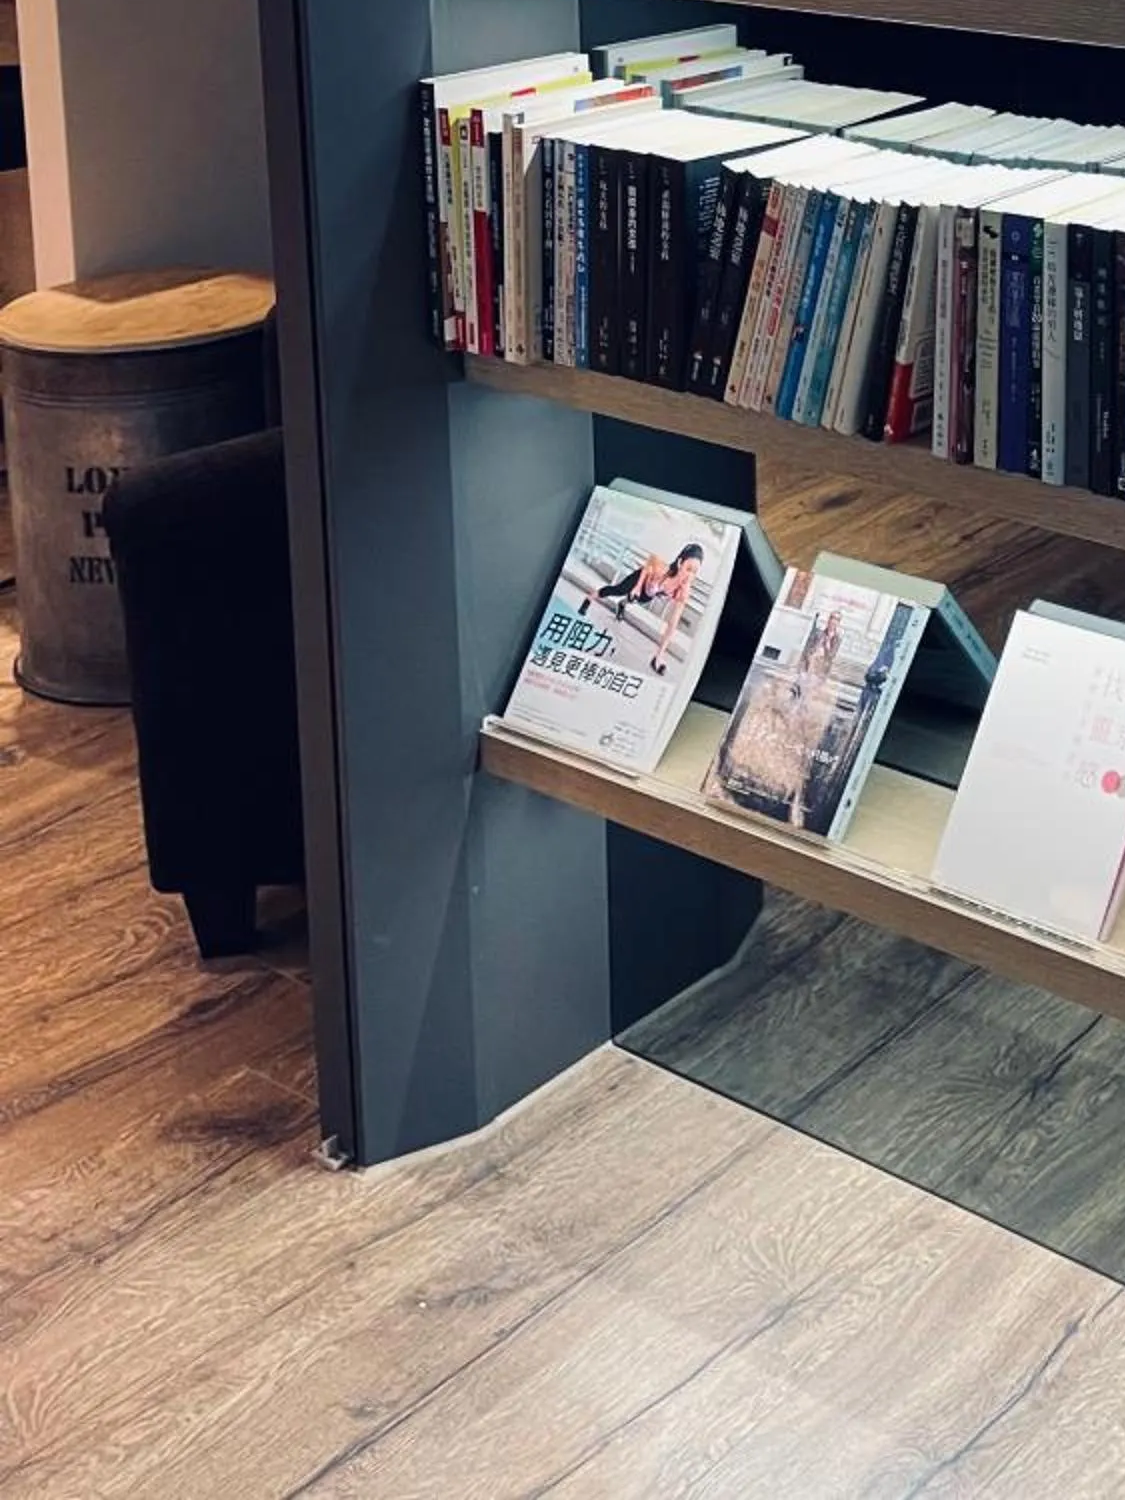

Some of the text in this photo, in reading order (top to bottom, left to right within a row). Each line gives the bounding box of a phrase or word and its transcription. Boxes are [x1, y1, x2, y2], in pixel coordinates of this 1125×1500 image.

[530, 649, 644, 699] 遇見更棒的自己
